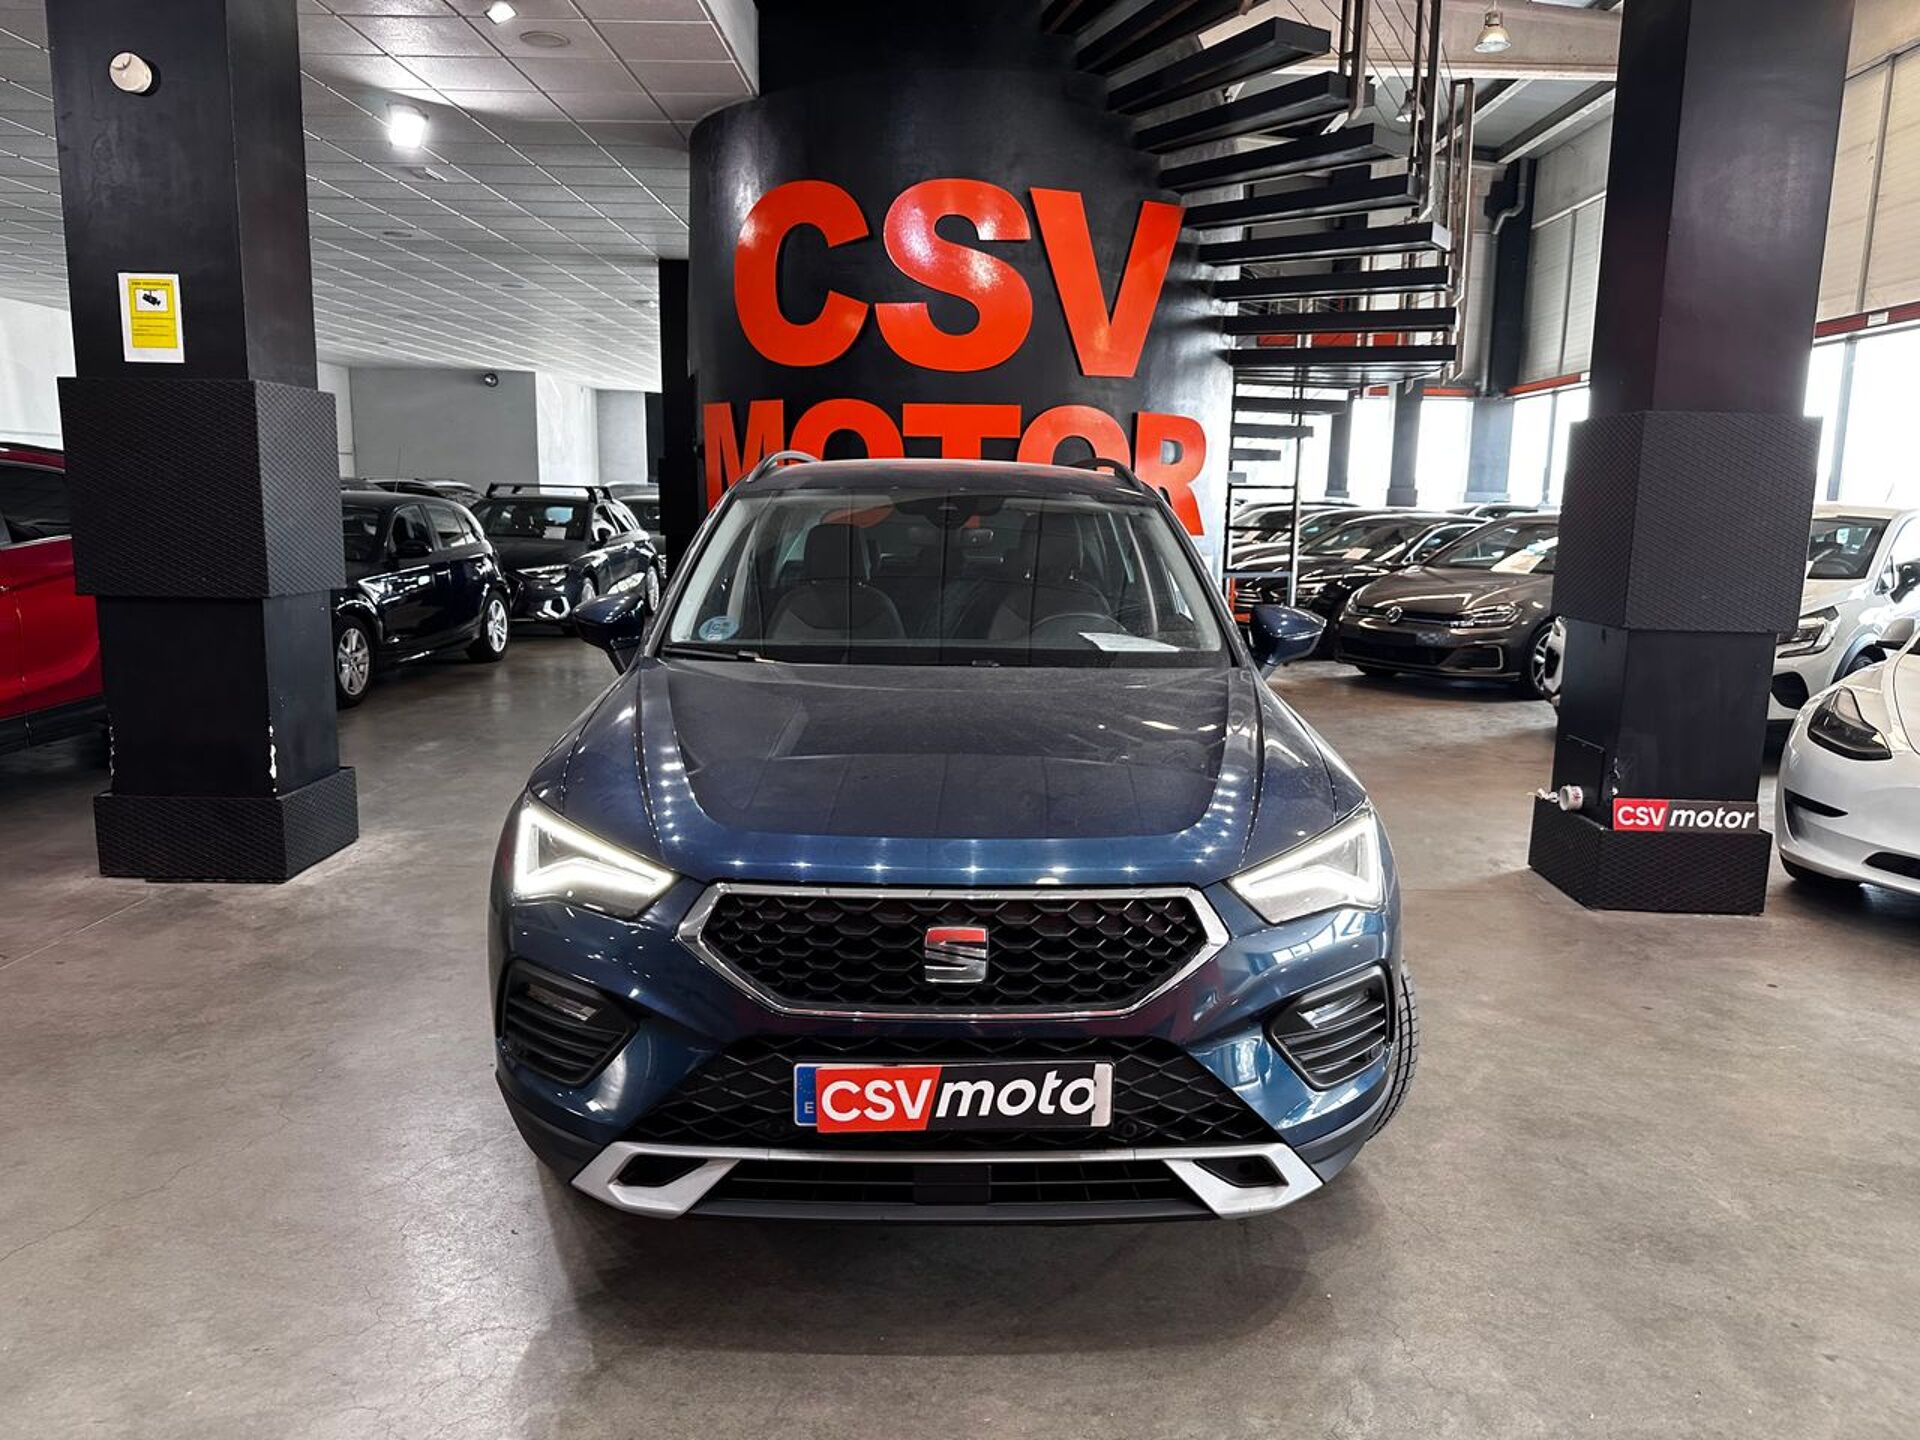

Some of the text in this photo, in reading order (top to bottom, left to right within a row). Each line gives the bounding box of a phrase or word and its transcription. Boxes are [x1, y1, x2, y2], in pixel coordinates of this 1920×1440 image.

[733, 178, 1185, 378] CSV
[1617, 806, 1756, 829] CSV motor
[821, 1079, 933, 1122] CSV
